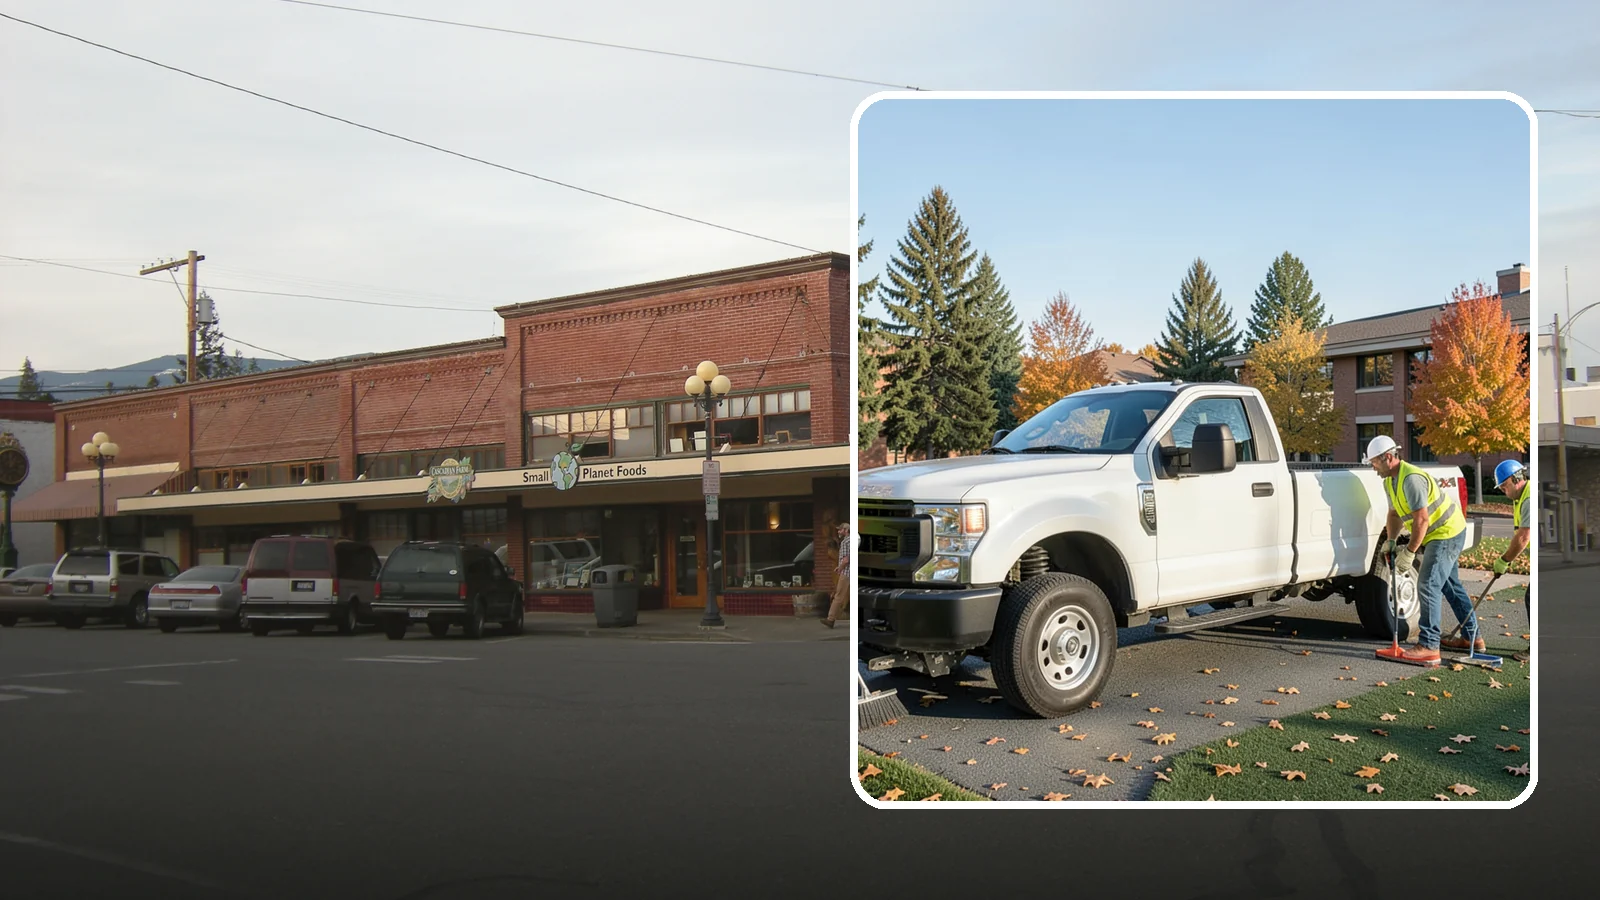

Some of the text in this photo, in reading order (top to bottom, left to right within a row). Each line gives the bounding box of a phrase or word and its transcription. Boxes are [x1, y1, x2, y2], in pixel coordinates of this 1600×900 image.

[523, 464, 647, 483] Small Planet Foods
